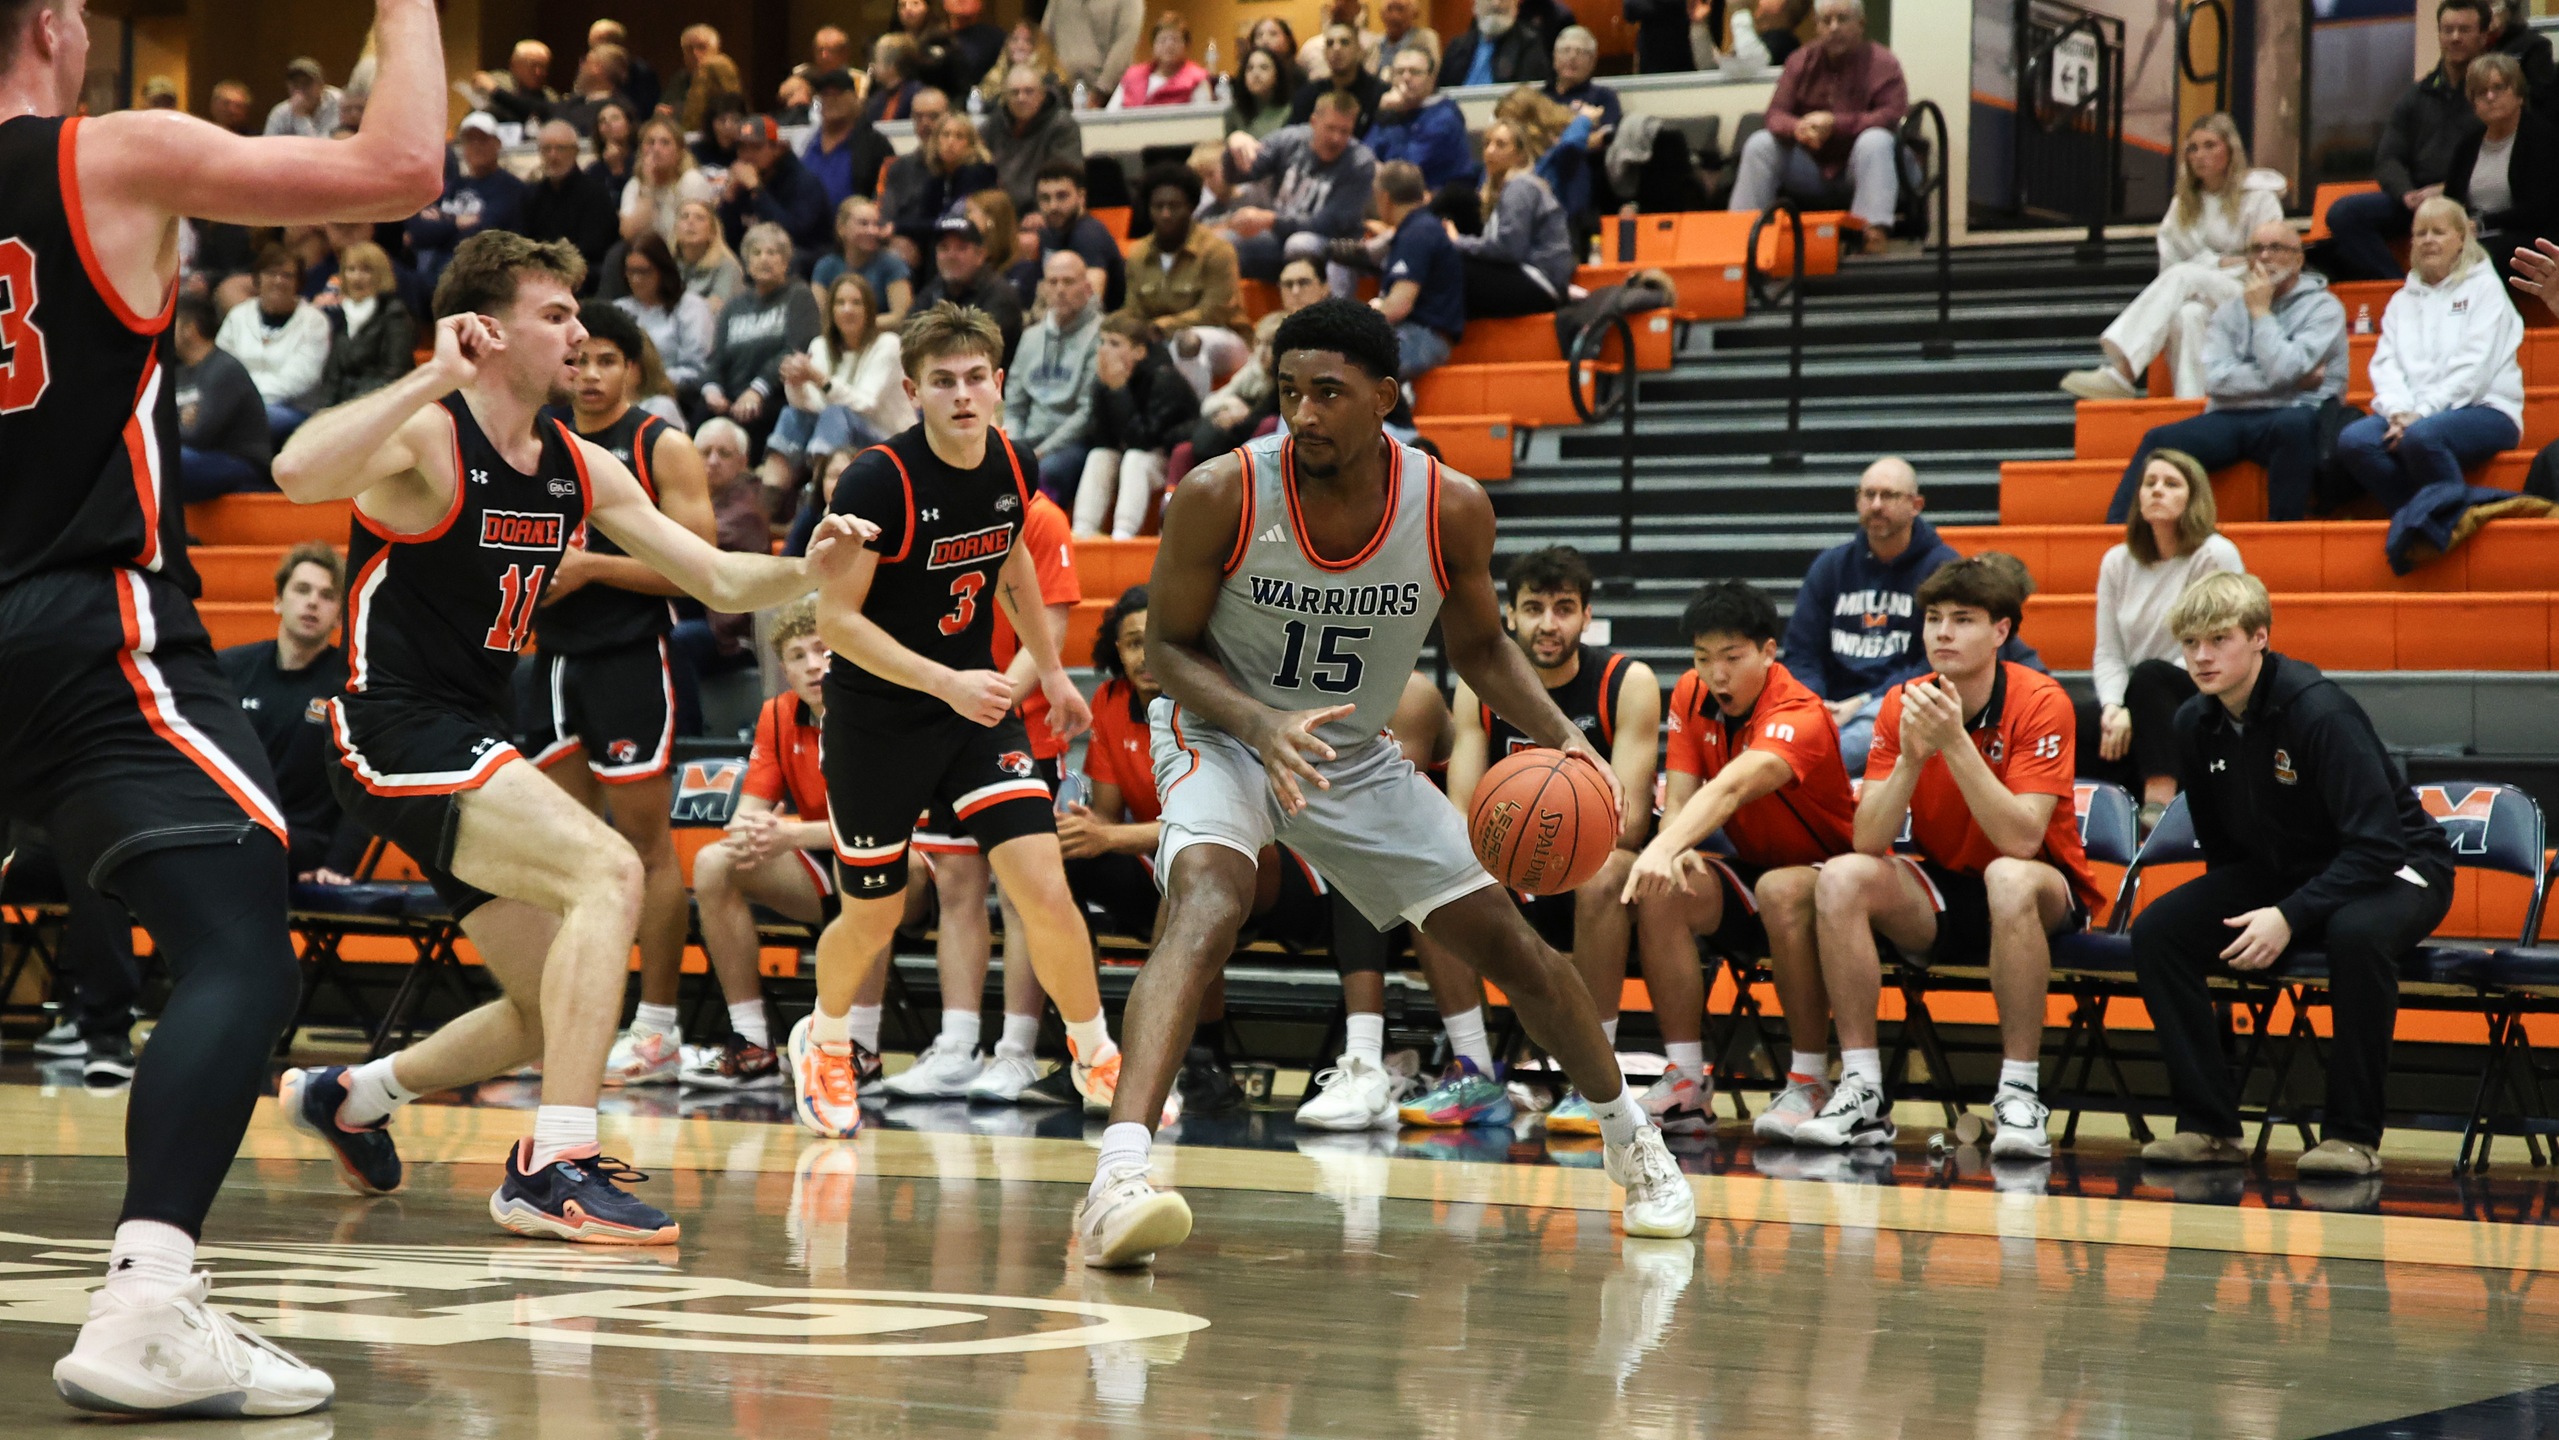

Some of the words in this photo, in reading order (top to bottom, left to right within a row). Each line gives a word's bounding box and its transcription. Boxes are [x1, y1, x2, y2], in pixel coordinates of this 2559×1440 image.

[0, 236, 50, 415] 3
[484, 516, 558, 545] DOANE
[933, 529, 1009, 564] DOANE
[1060, 544, 1070, 568] 1
[484, 563, 545, 652] 11
[938, 570, 986, 636] 3
[1249, 575, 1420, 616] WARRIORS
[1270, 619, 1373, 695] 15
[2035, 734, 2062, 759] 15
